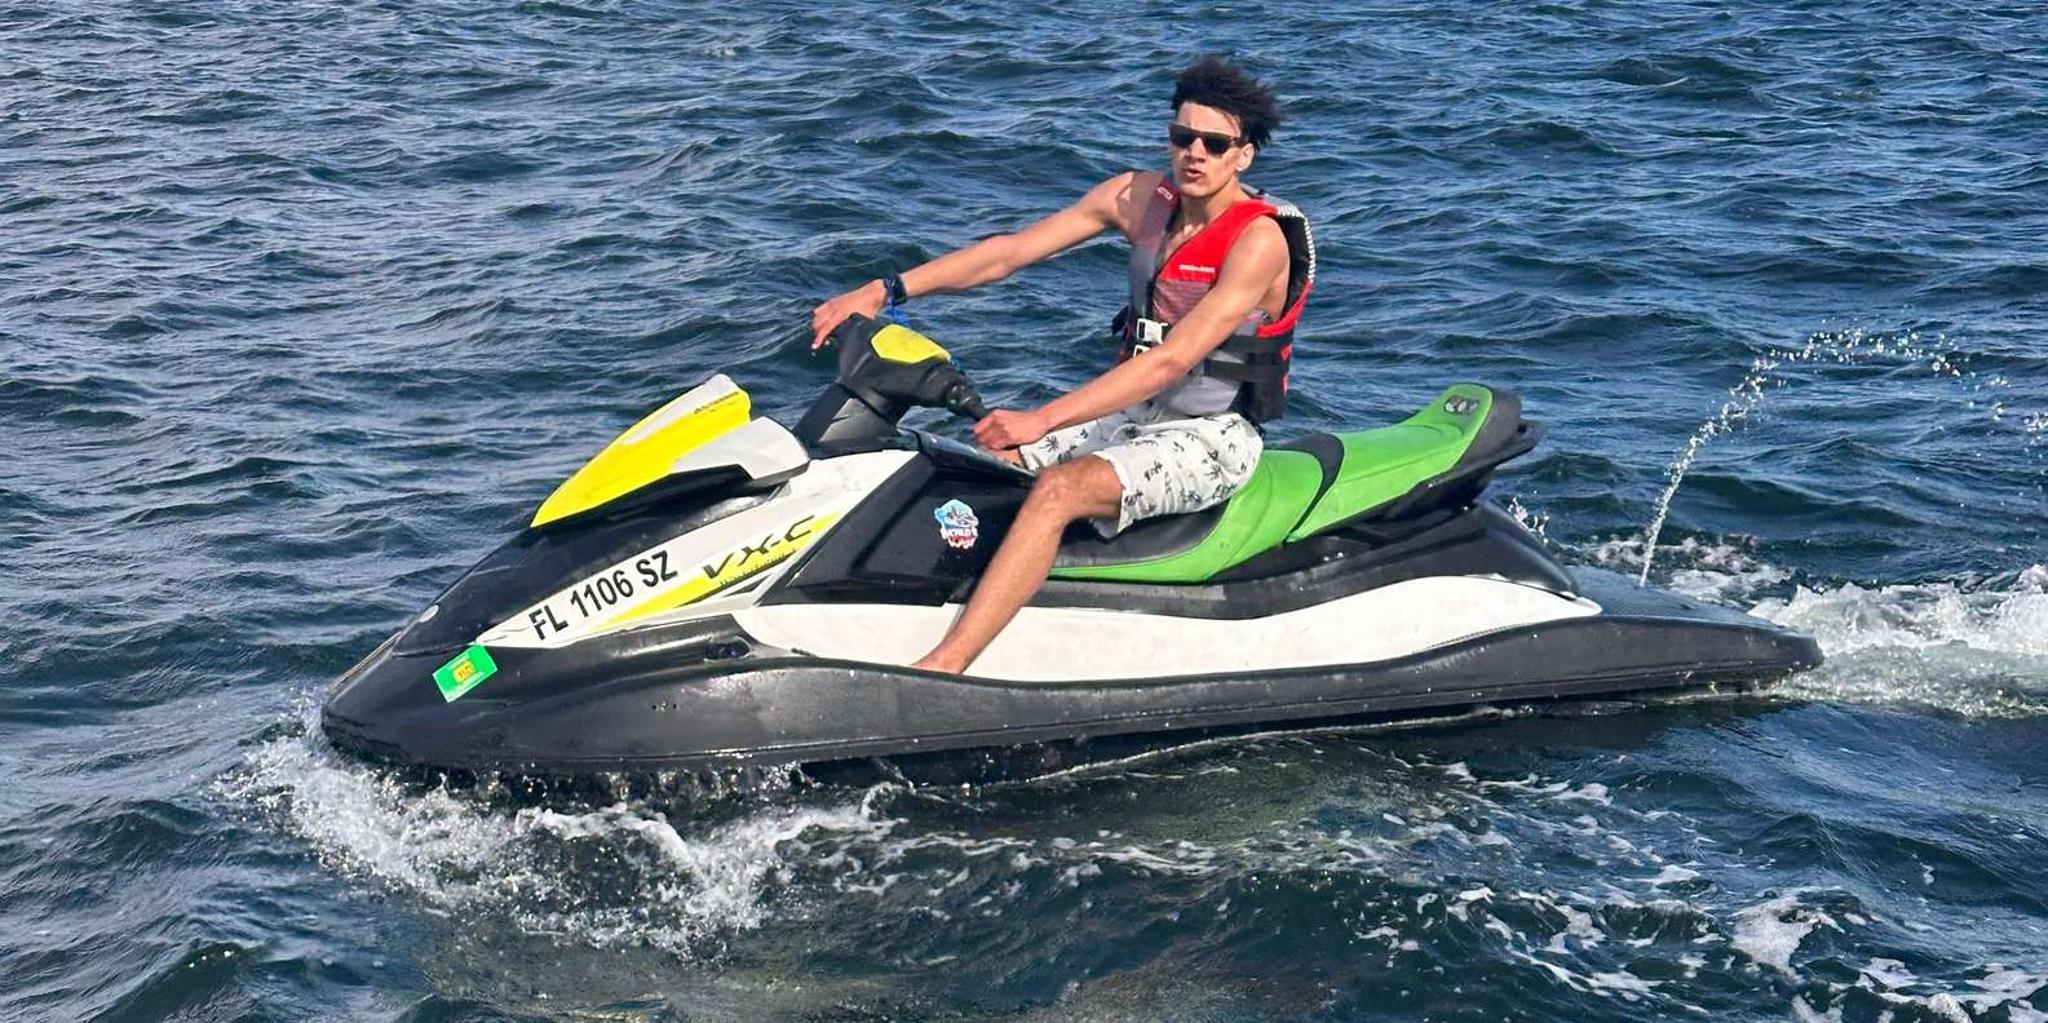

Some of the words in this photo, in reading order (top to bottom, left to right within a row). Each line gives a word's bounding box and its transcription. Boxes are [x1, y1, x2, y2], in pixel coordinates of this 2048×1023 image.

[702, 515, 815, 579] VX-C
[528, 605, 569, 640] FL
[570, 569, 634, 618] 1106
[635, 549, 678, 587] SZ
